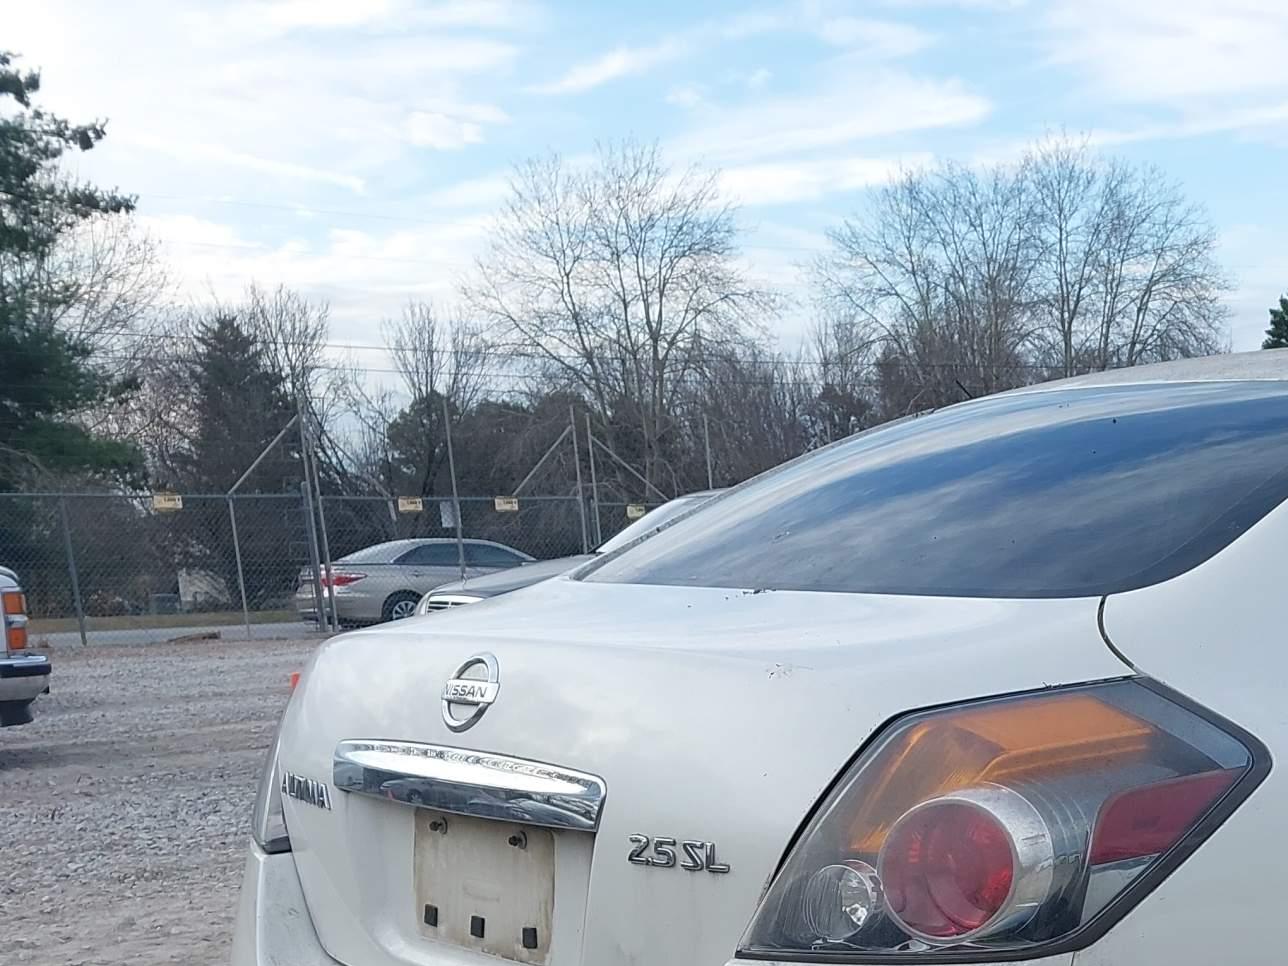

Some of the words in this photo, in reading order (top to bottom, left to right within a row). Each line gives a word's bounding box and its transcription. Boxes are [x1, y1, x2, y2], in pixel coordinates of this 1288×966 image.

[445, 683, 488, 699] NISSAN
[281, 771, 332, 811] ALTIMA
[680, 840, 731, 873] SL
